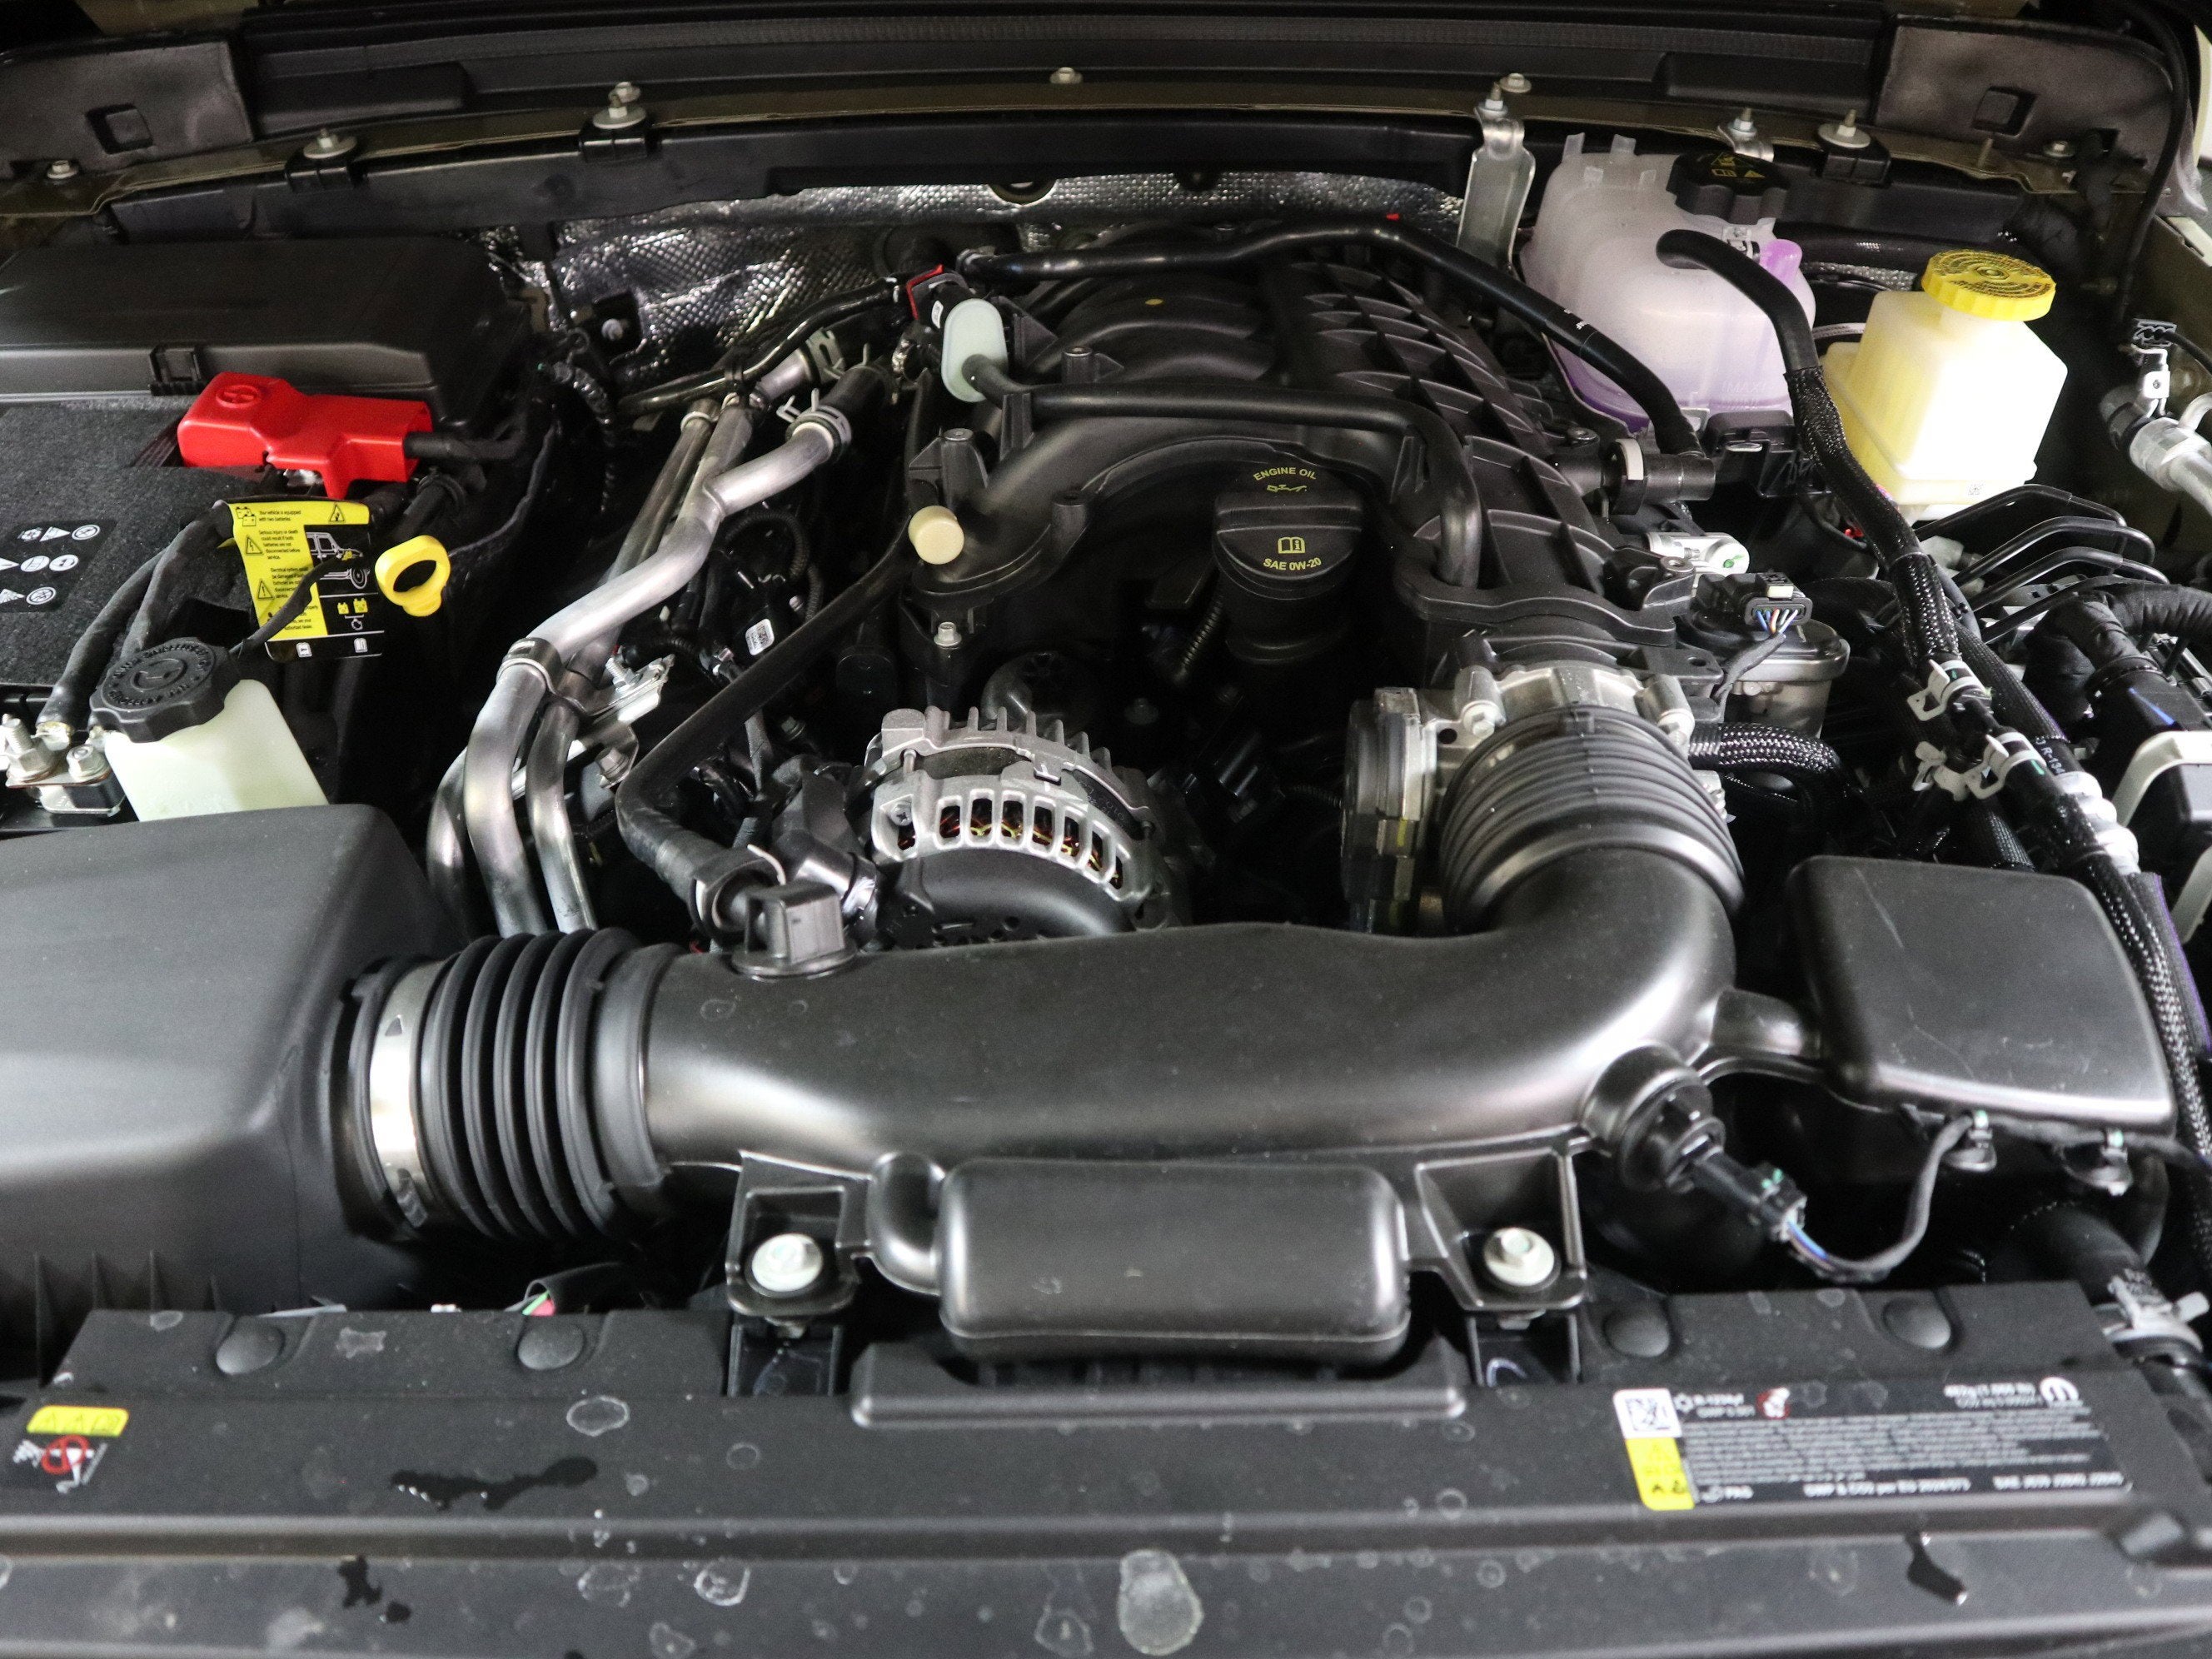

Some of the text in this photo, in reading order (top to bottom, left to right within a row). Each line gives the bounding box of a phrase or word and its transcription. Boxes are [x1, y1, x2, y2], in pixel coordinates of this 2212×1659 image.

[1253, 467, 1317, 481] ENGINE OIL
[1263, 557, 1322, 571] SAE 0W-20
